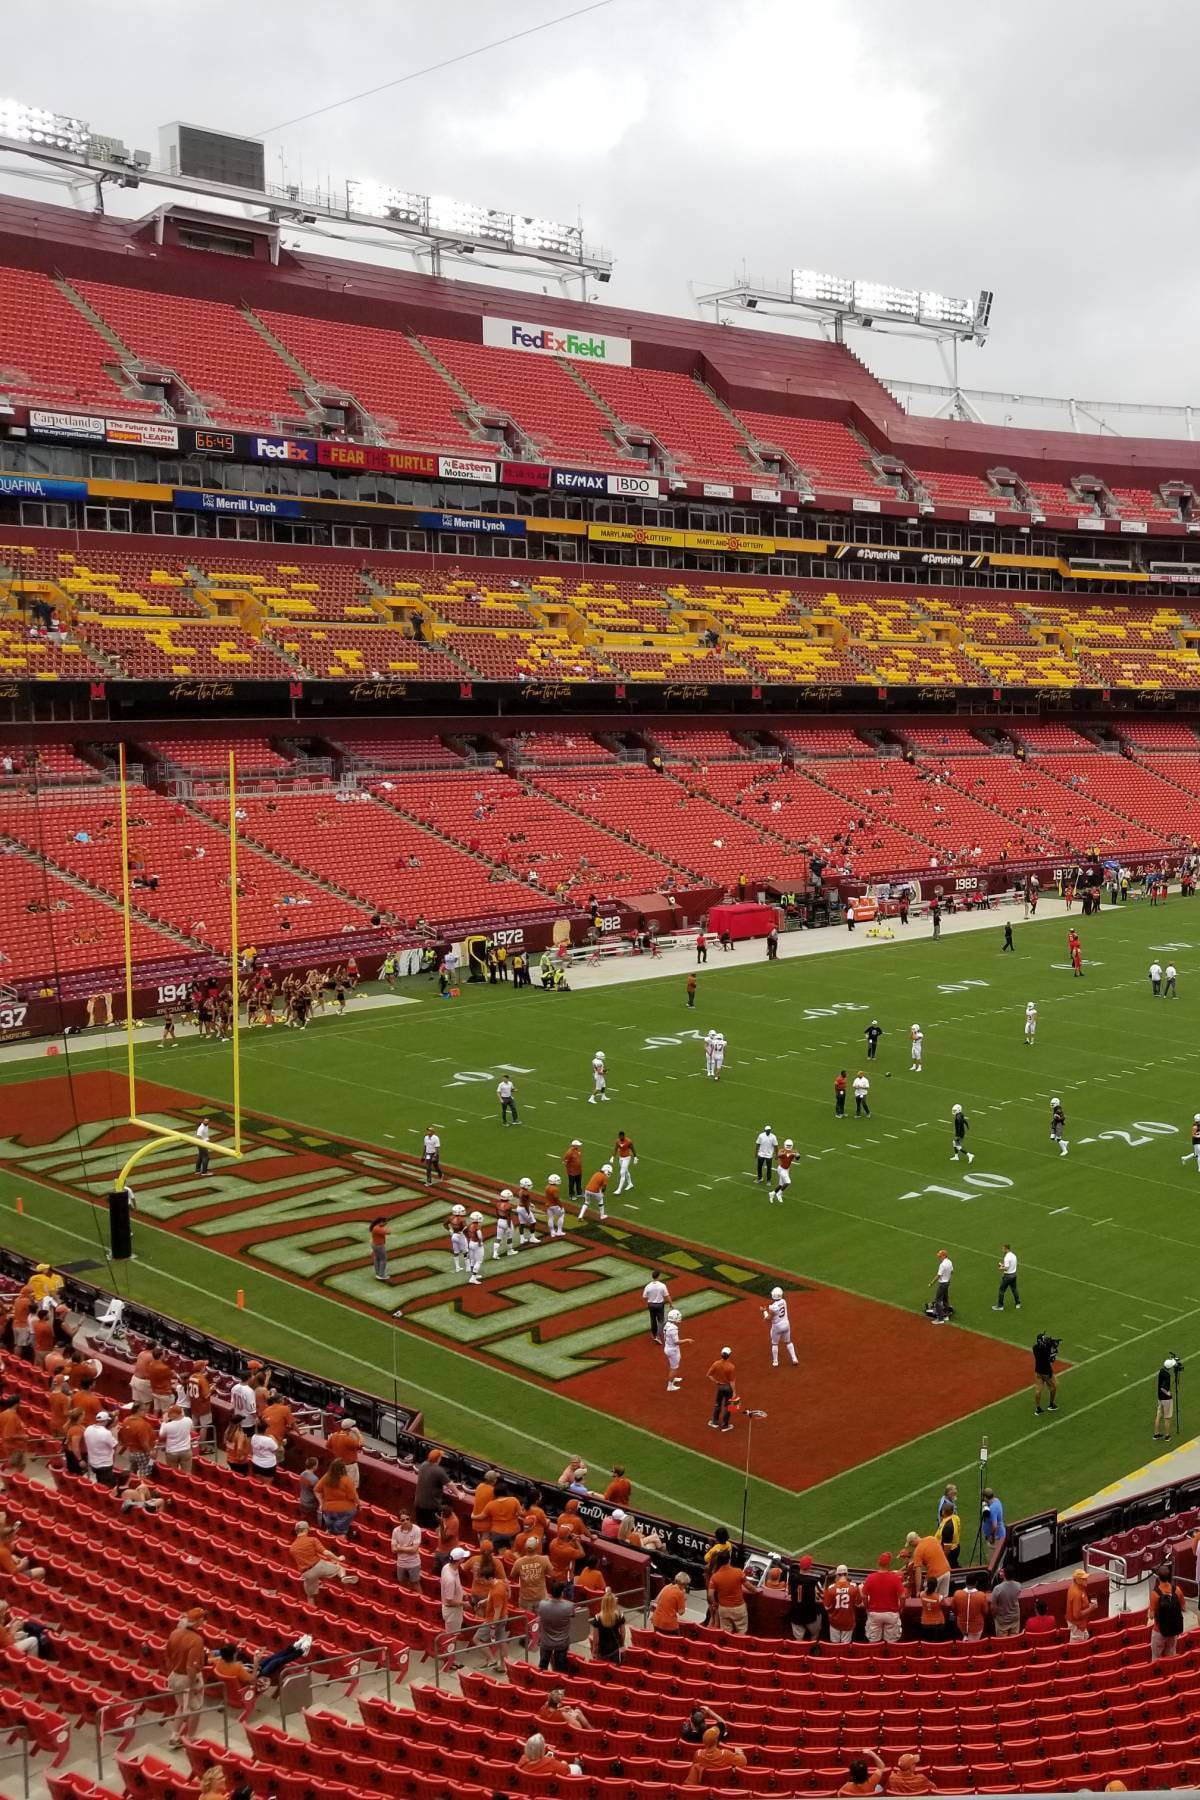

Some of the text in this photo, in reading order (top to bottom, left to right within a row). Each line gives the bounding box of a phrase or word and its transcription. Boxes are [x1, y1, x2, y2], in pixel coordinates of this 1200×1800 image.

[512, 325, 605, 358] FedExField
[33, 411, 91, 428] Carpetland
[110, 421, 124, 430] The
[124, 422, 148, 431] Future
[109, 430, 141, 442] Support
[142, 433, 175, 443] LEARN
[257, 437, 308, 461] FedEx
[451, 459, 492, 473] Eastern
[556, 473, 604, 489] RE/MAX
[620, 478, 650, 492] BDO
[216, 497, 276, 513] Merrill Lynch
[453, 517, 505, 532] Merrill Lynch
[600, 530, 673, 542] MARYLAND LOTTERY
[696, 537, 764, 549] MARYLAND LOTTERY
[863, 549, 900, 561] Ameritel
[928, 554, 963, 565] Ameritel
[955, 878, 977, 890] 1983
[600, 915, 621, 932] 982
[492, 929, 524, 947] 1972
[1099, 1120, 1181, 1147] 20
[923, 1172, 1014, 1202] 10
[778, 1306, 786, 1319] 3
[576, 1500, 612, 1522] FanDu
[676, 1534, 710, 1552] SEATS
[835, 1594, 849, 1609] 12
